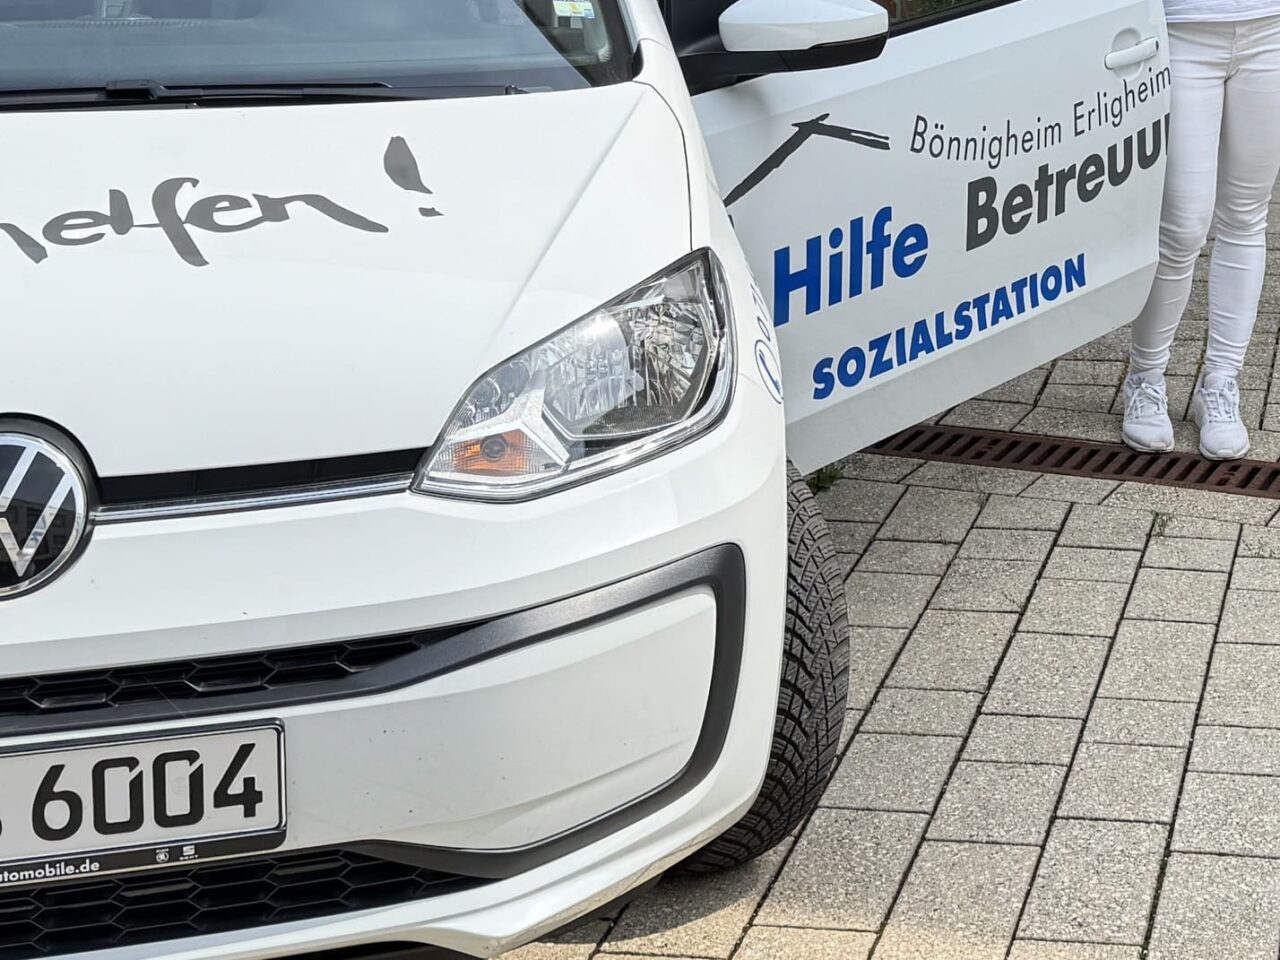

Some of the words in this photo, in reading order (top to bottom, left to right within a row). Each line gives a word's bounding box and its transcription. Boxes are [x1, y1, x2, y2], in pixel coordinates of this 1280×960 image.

[909, 114, 1062, 169] Bönnigheim
[1073, 67, 1171, 138] Erligheim
[773, 206, 929, 328] Hilfe
[812, 253, 1087, 400] SOZIALSTATION
[31, 742, 264, 842] 6004
